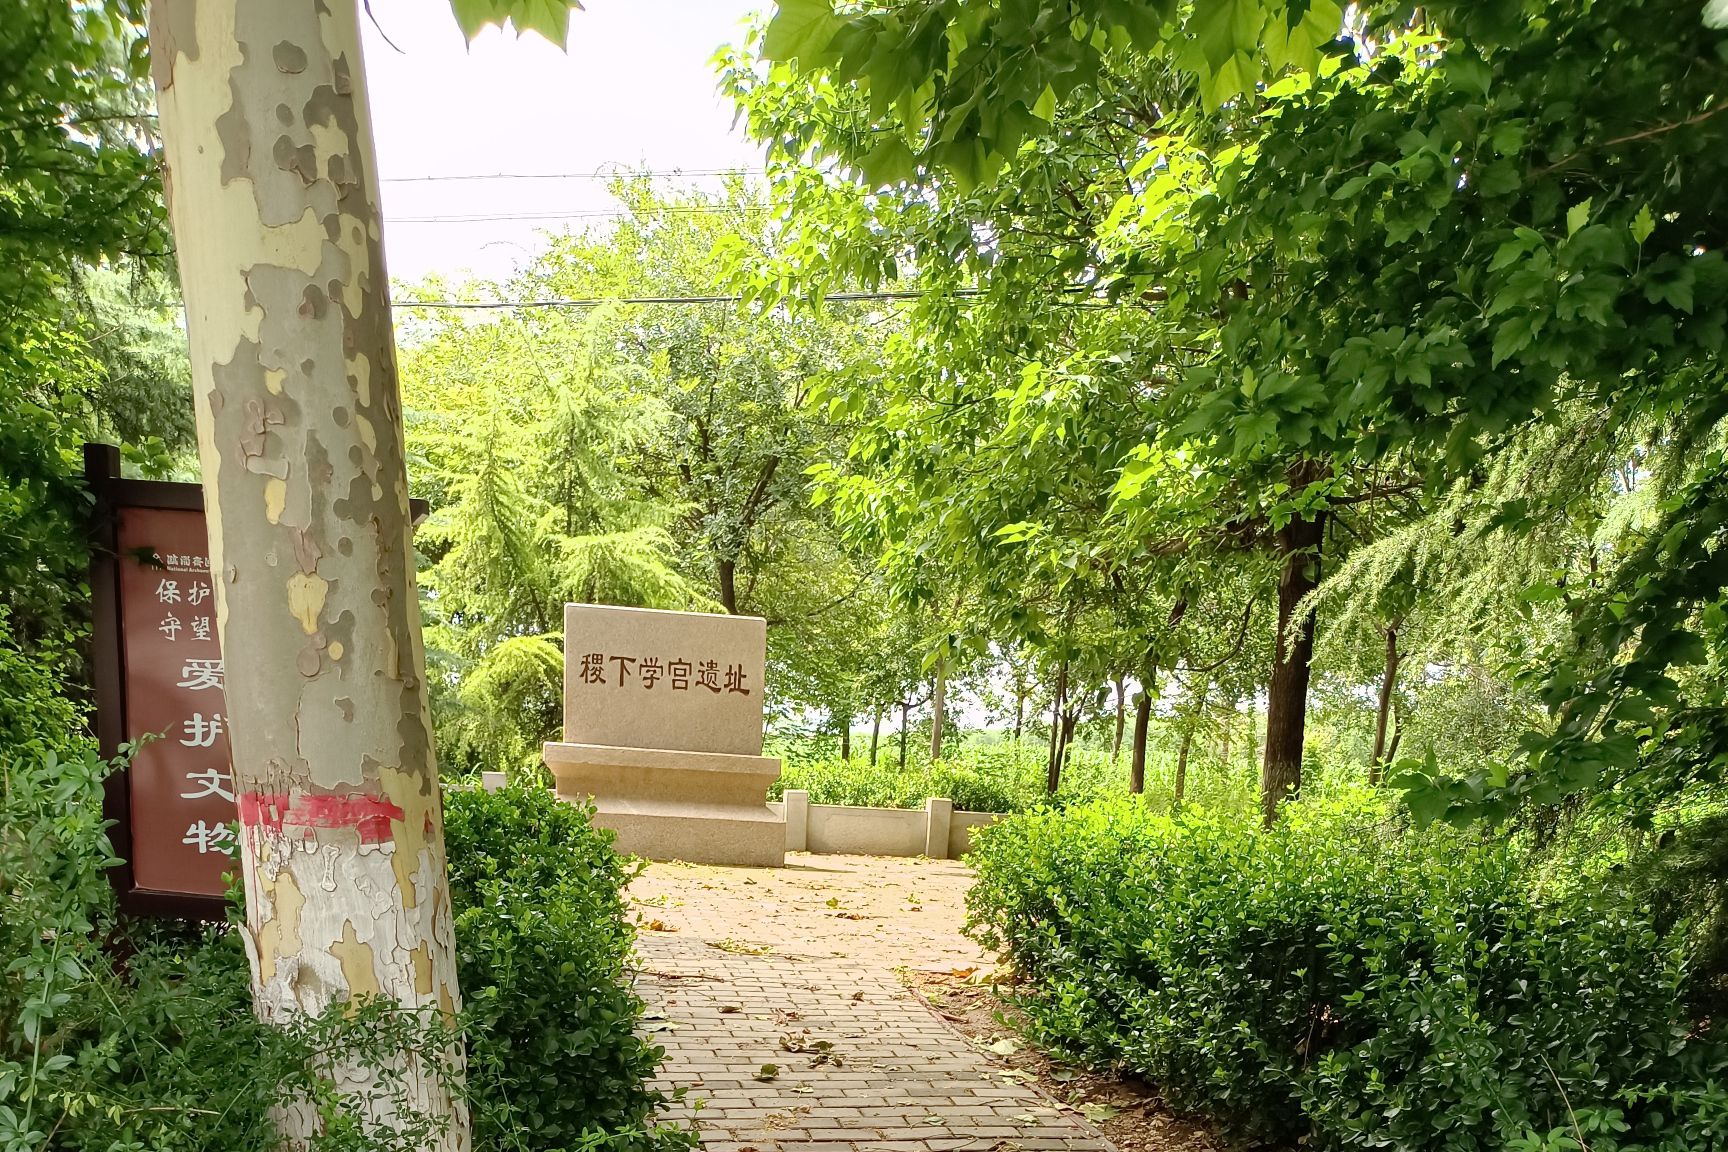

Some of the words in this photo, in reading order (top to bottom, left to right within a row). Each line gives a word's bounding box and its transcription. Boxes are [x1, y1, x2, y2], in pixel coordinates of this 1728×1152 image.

[579, 653, 751, 696] 稷下学宫遗址
